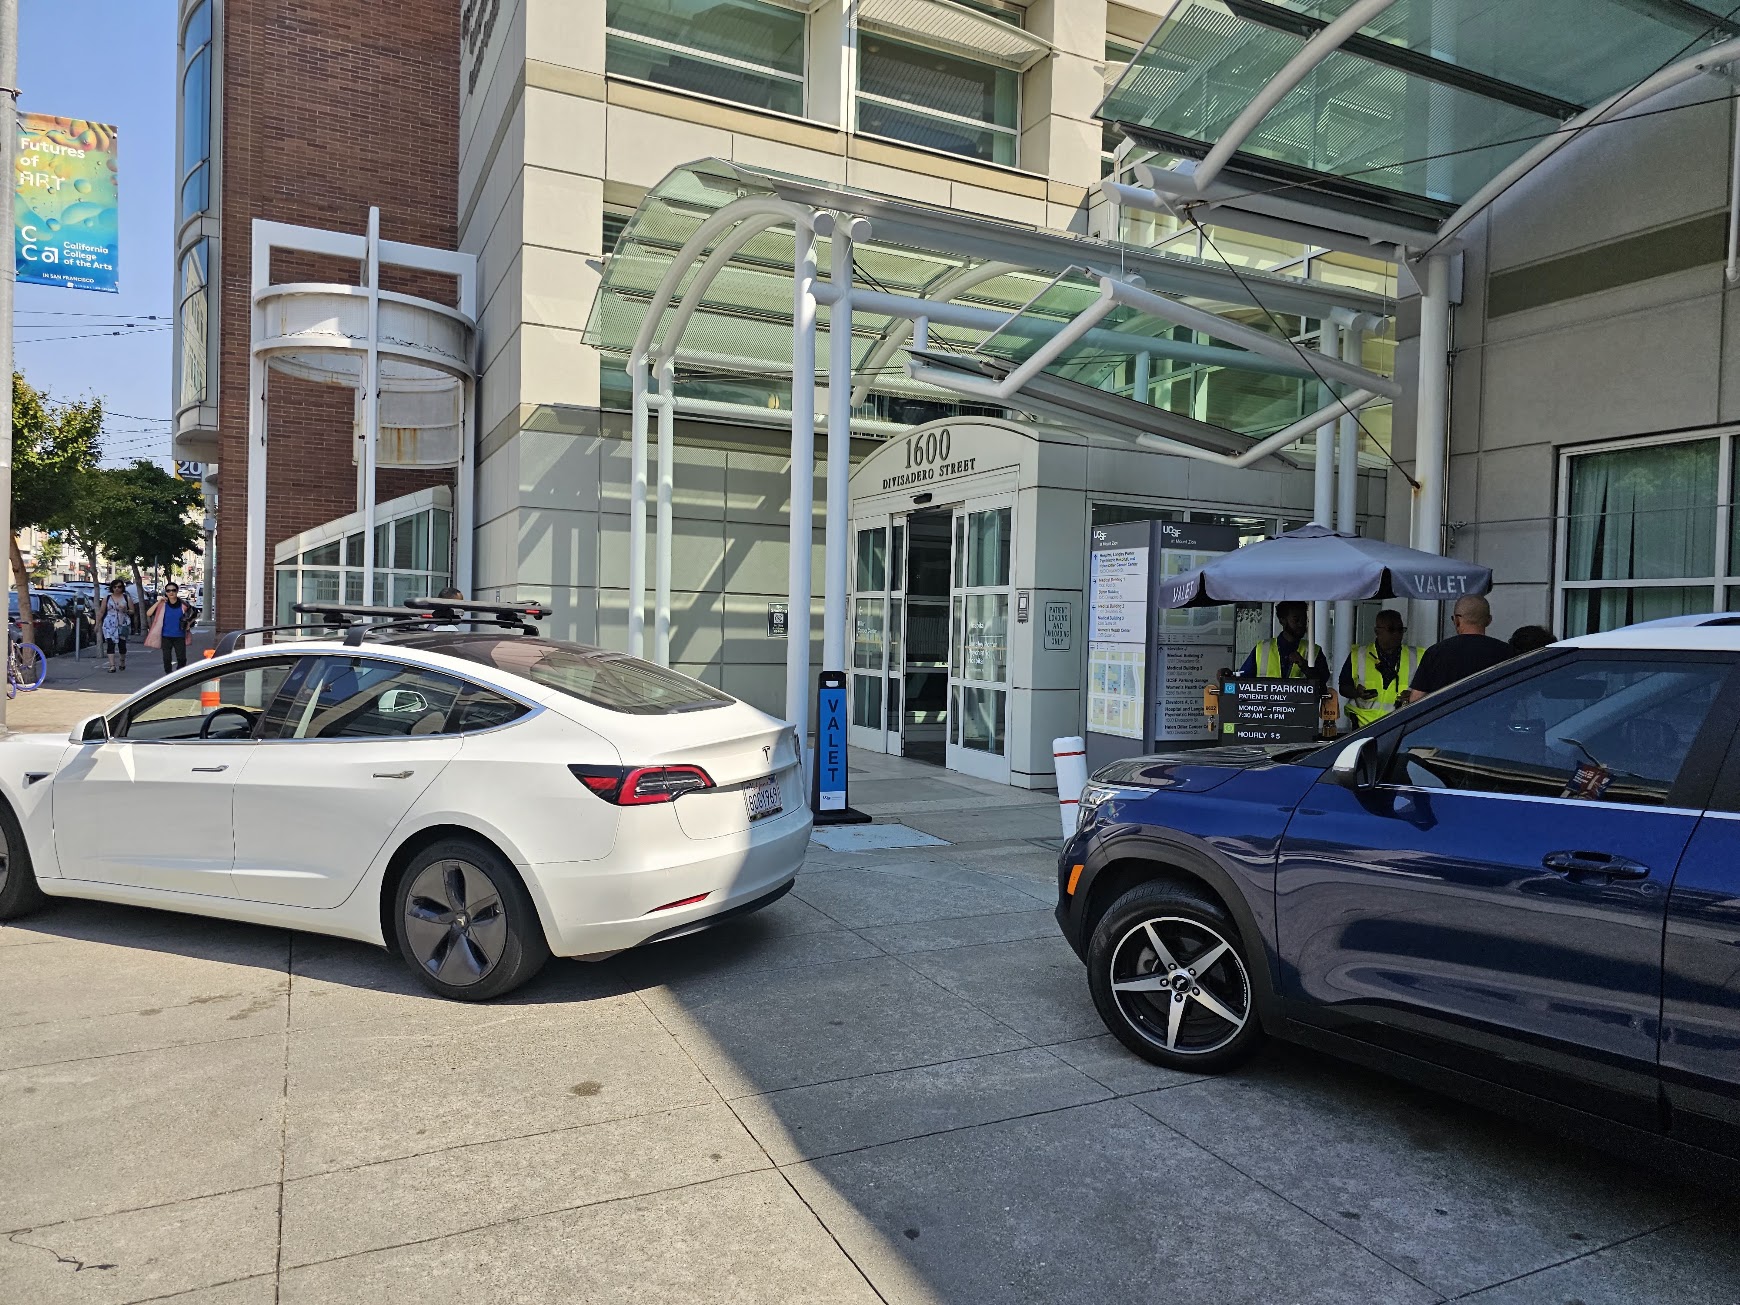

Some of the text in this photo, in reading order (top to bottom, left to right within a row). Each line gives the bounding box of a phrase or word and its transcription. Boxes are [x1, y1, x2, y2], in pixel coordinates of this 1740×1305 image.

[21, 138, 85, 158] Futures
[20, 155, 39, 167] of
[20, 170, 65, 190] ART
[64, 241, 109, 254] California
[64, 250, 97, 260] College
[76, 259, 91, 267] the
[93, 262, 113, 270] Arts
[905, 429, 950, 469] 1600
[178, 461, 202, 474] 20
[882, 458, 976, 489] DIVISADERO STREET
[1094, 531, 1107, 540] UCSF
[1163, 526, 1181, 537] UCSF
[1414, 575, 1466, 594] VALET
[1173, 581, 1194, 602] VALET
[1239, 684, 1268, 692] VALET
[1271, 685, 1314, 694] PARKING
[828, 699, 839, 782] VALET
